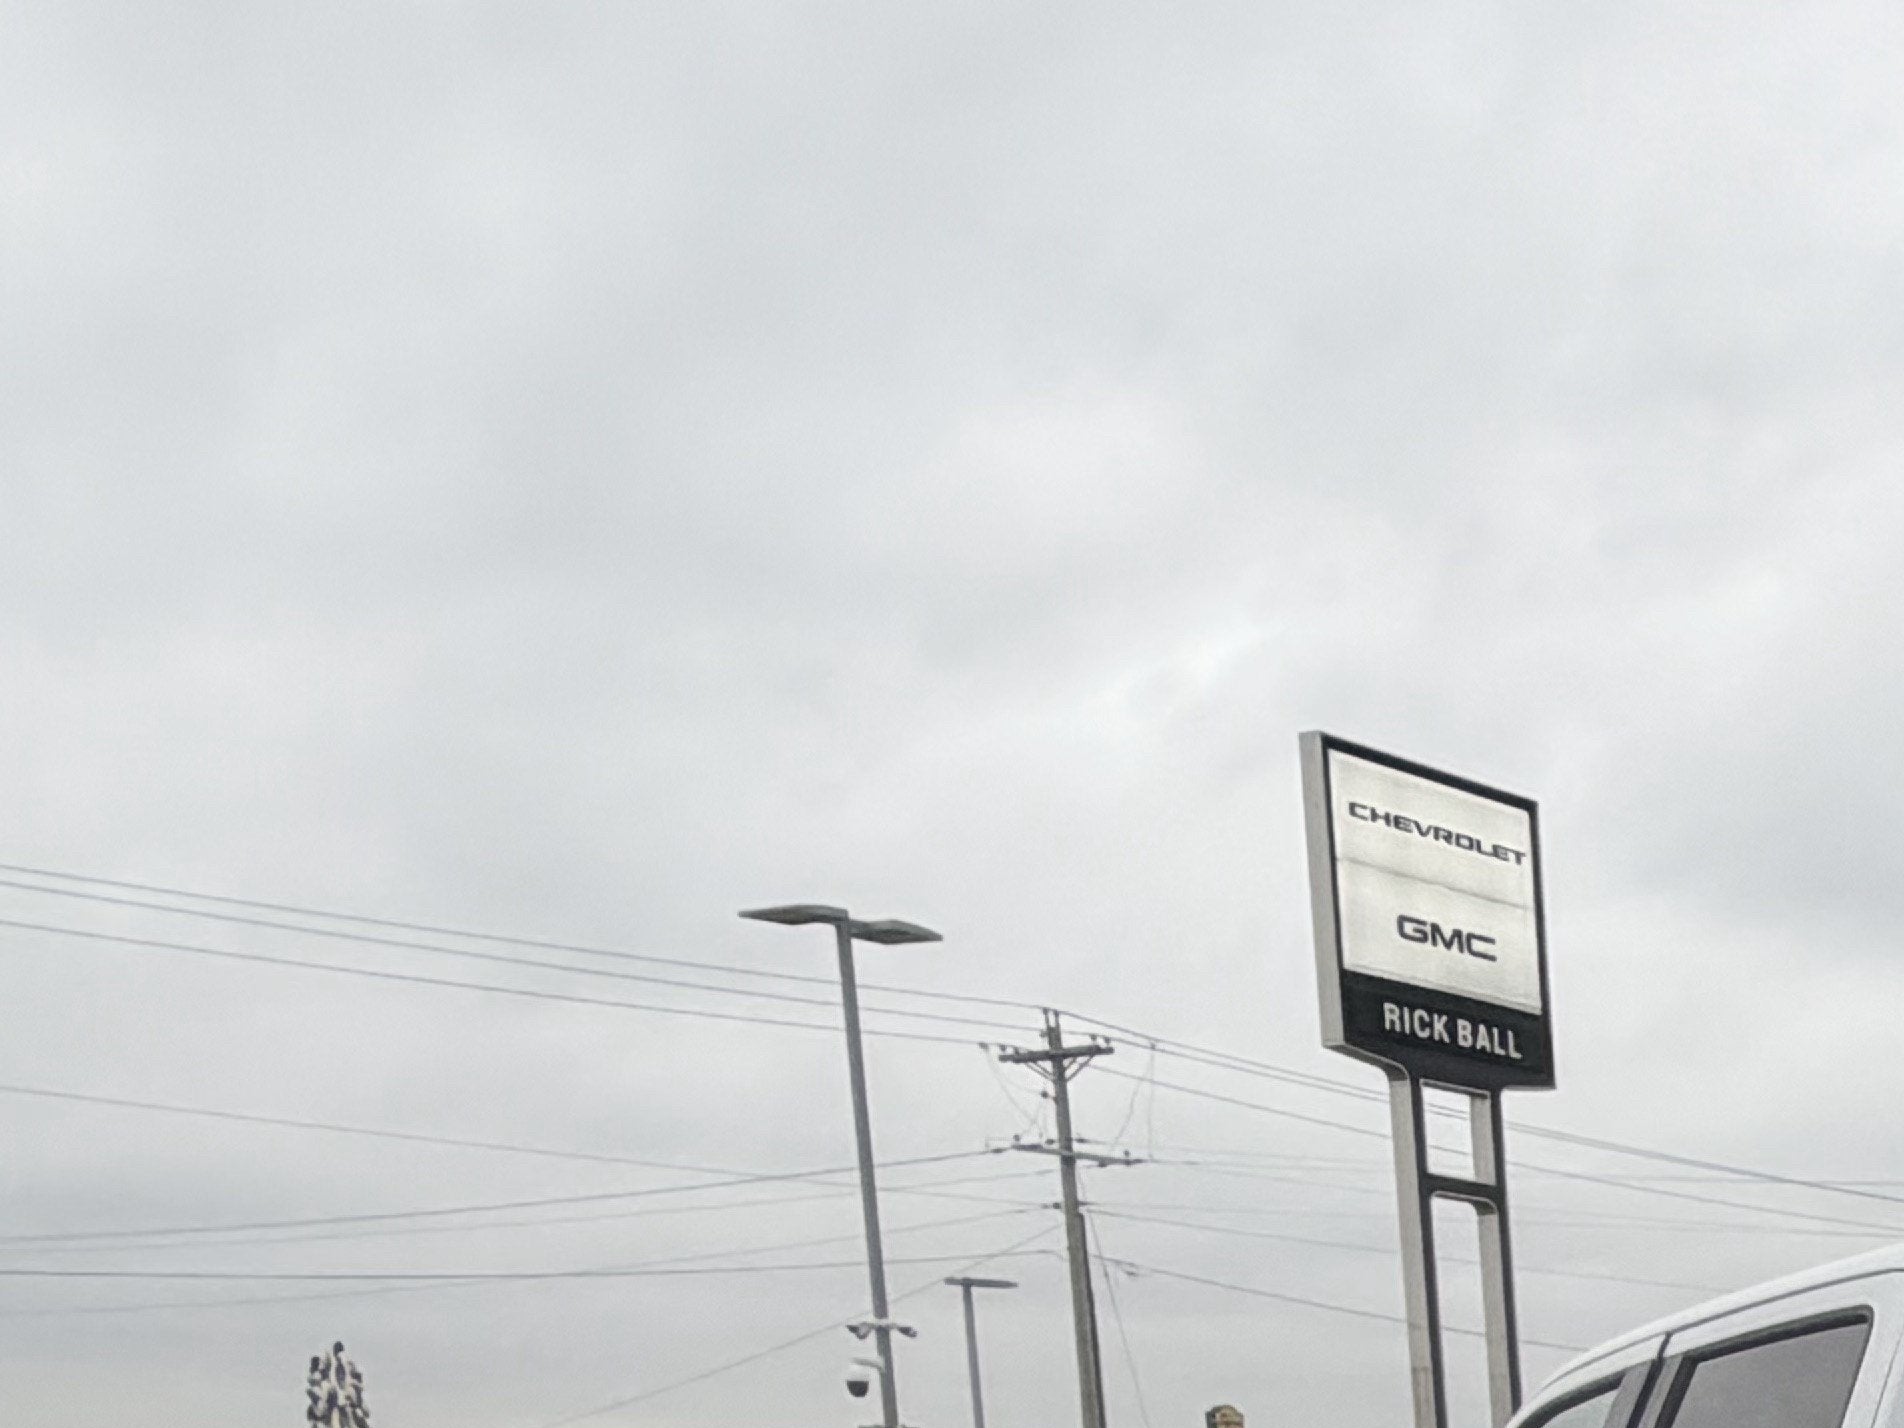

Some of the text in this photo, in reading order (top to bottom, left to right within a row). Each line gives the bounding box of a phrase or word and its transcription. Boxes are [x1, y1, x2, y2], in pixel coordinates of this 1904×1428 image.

[1348, 802, 1527, 866] CHEVROLET
[1397, 914, 1498, 963] GMC
[1383, 1002, 1522, 1060] RICK BALL
